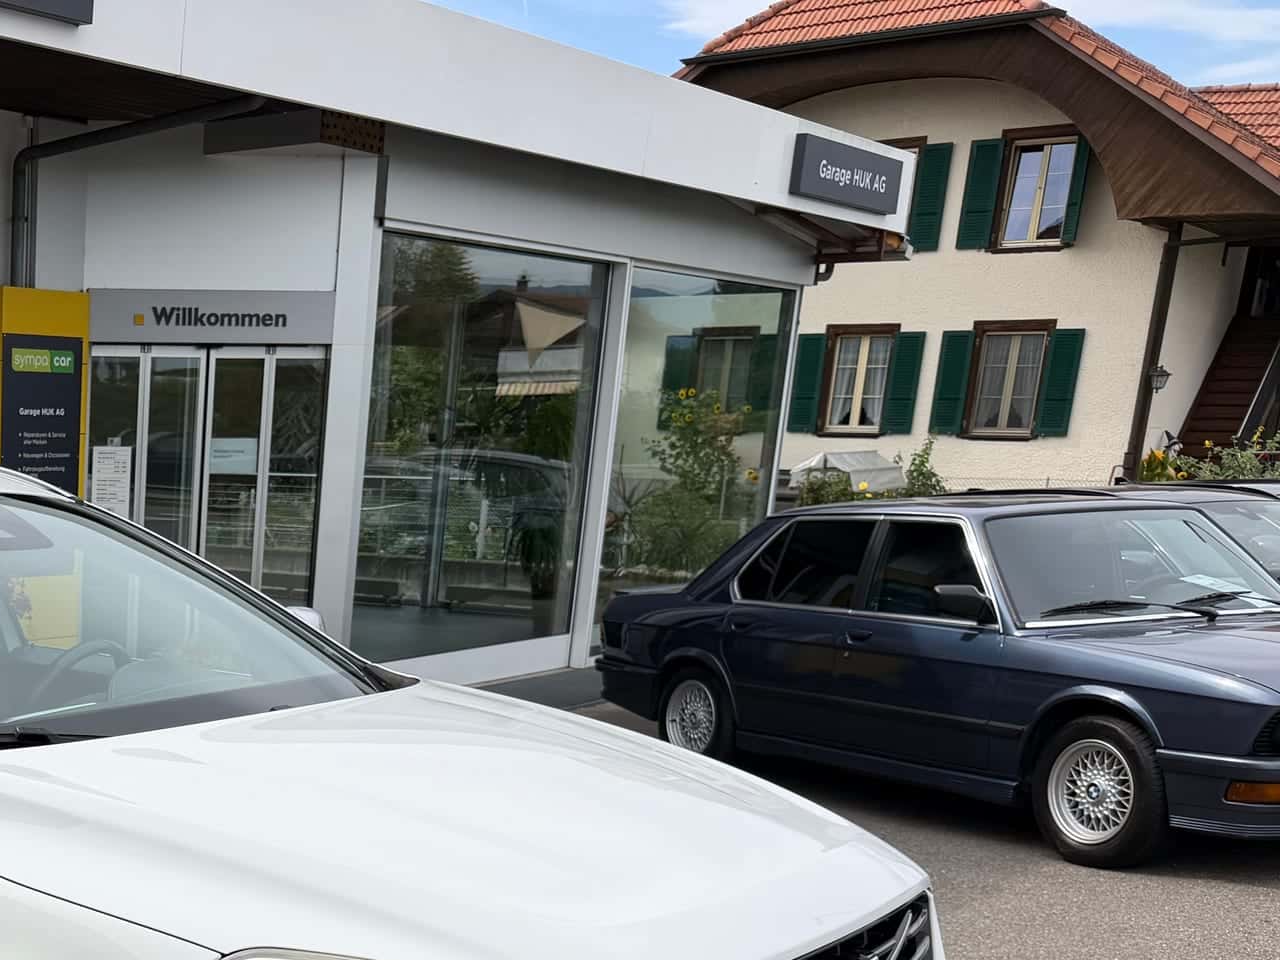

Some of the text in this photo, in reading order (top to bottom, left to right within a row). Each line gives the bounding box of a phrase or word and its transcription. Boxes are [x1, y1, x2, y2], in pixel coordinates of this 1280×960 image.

[819, 160, 887, 193] Garage HUK AG
[152, 306, 288, 328] Willkommen
[14, 354, 72, 369] sympa car
[18, 407, 65, 417] Garage HUK AG
